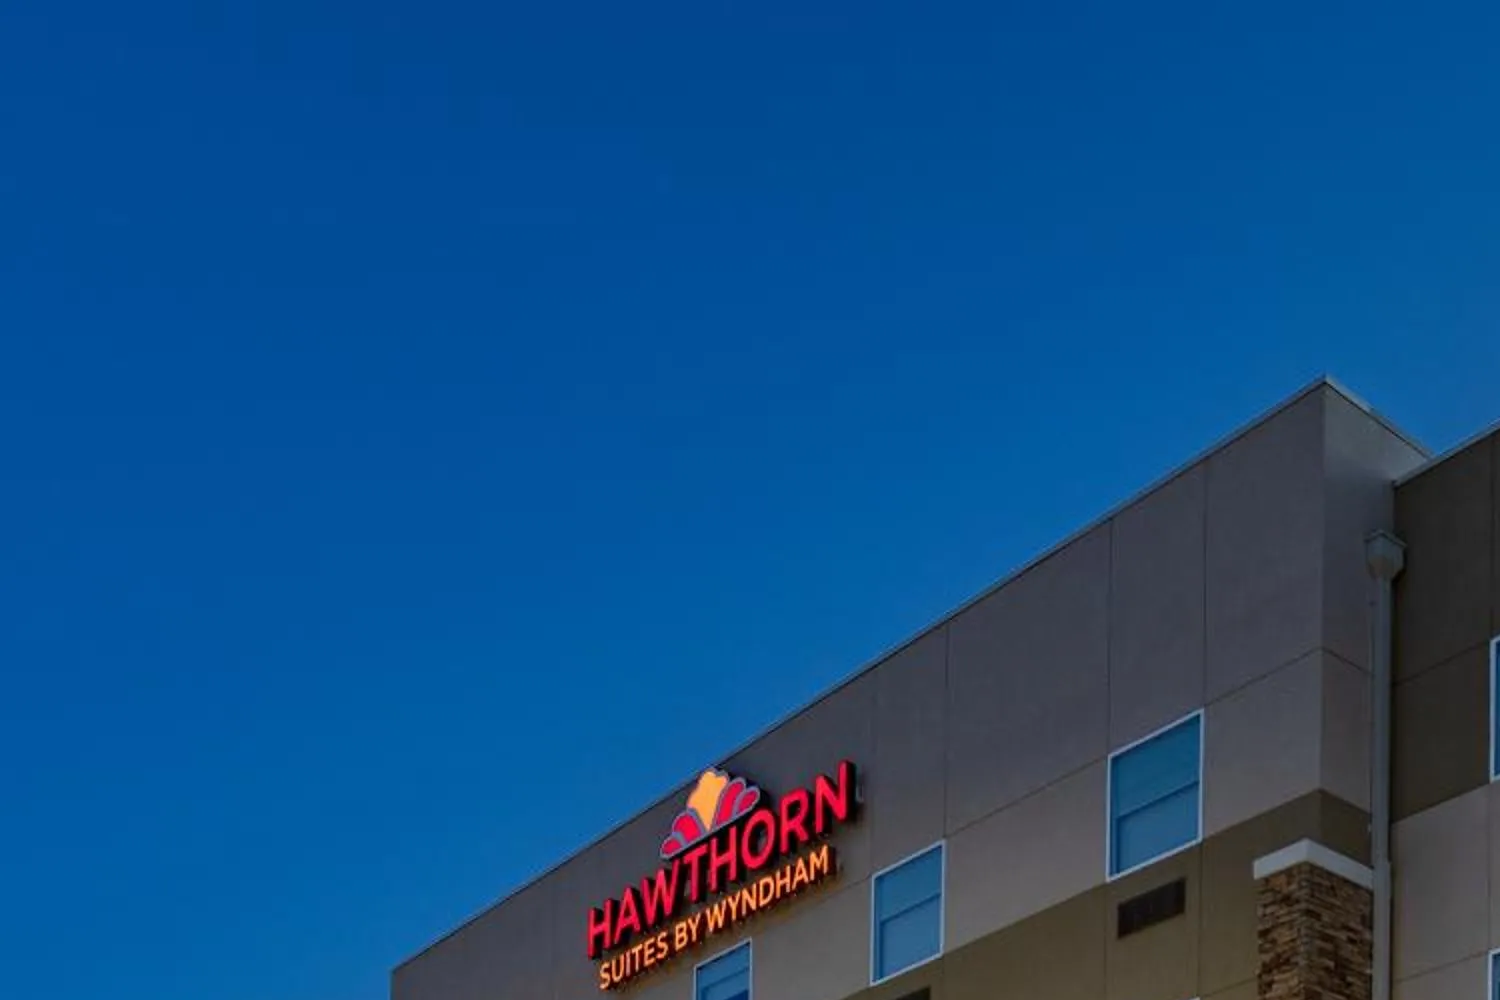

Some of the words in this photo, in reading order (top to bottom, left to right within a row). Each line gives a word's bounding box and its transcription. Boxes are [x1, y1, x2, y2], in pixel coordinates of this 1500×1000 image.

[587, 760, 850, 960] HAWTHORN
[599, 931, 669, 990] SUITES
[675, 912, 700, 949] BY
[705, 844, 829, 932] WYNDHAM
